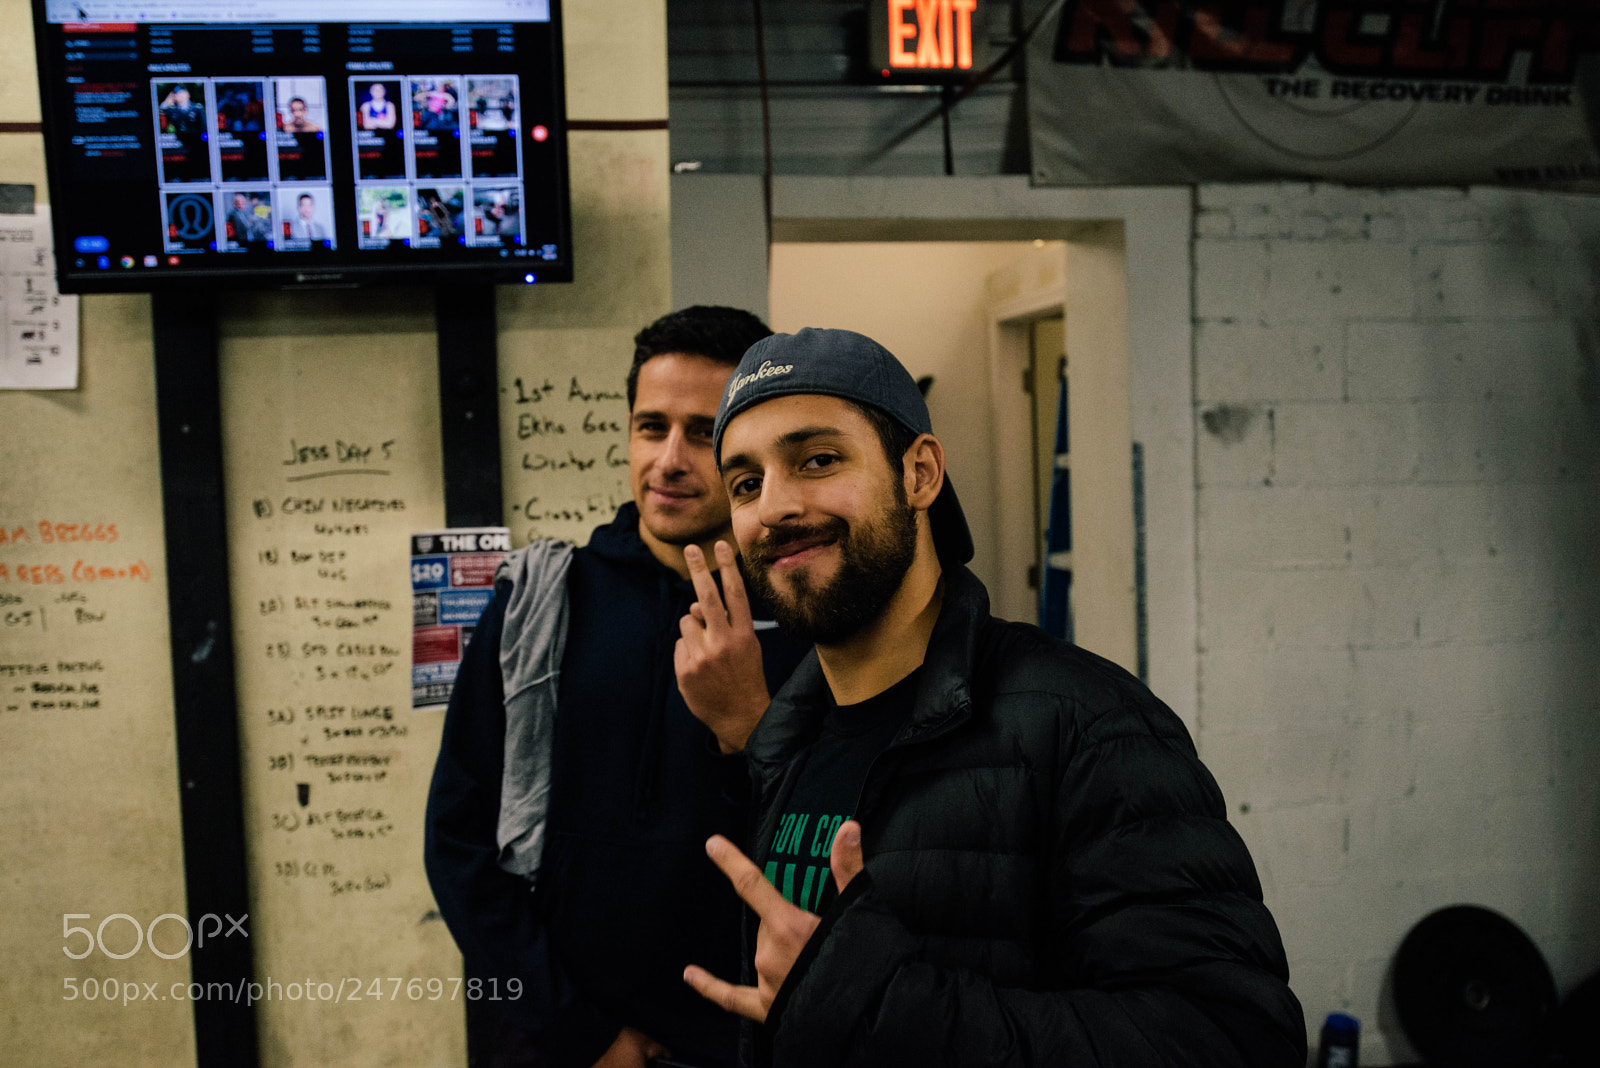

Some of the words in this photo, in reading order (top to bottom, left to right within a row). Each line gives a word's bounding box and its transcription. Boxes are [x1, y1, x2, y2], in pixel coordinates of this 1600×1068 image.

[888, 0, 977, 69] EXIT
[1264, 78, 1319, 98] THE
[1332, 80, 1479, 103] RECOVERY
[1485, 85, 1573, 107] DRINK
[726, 360, 794, 408] Yankees
[381, 439, 395, 460] 5
[439, 535, 476, 552] THE
[411, 563, 445, 583] $20
[809, 813, 851, 858] CO
